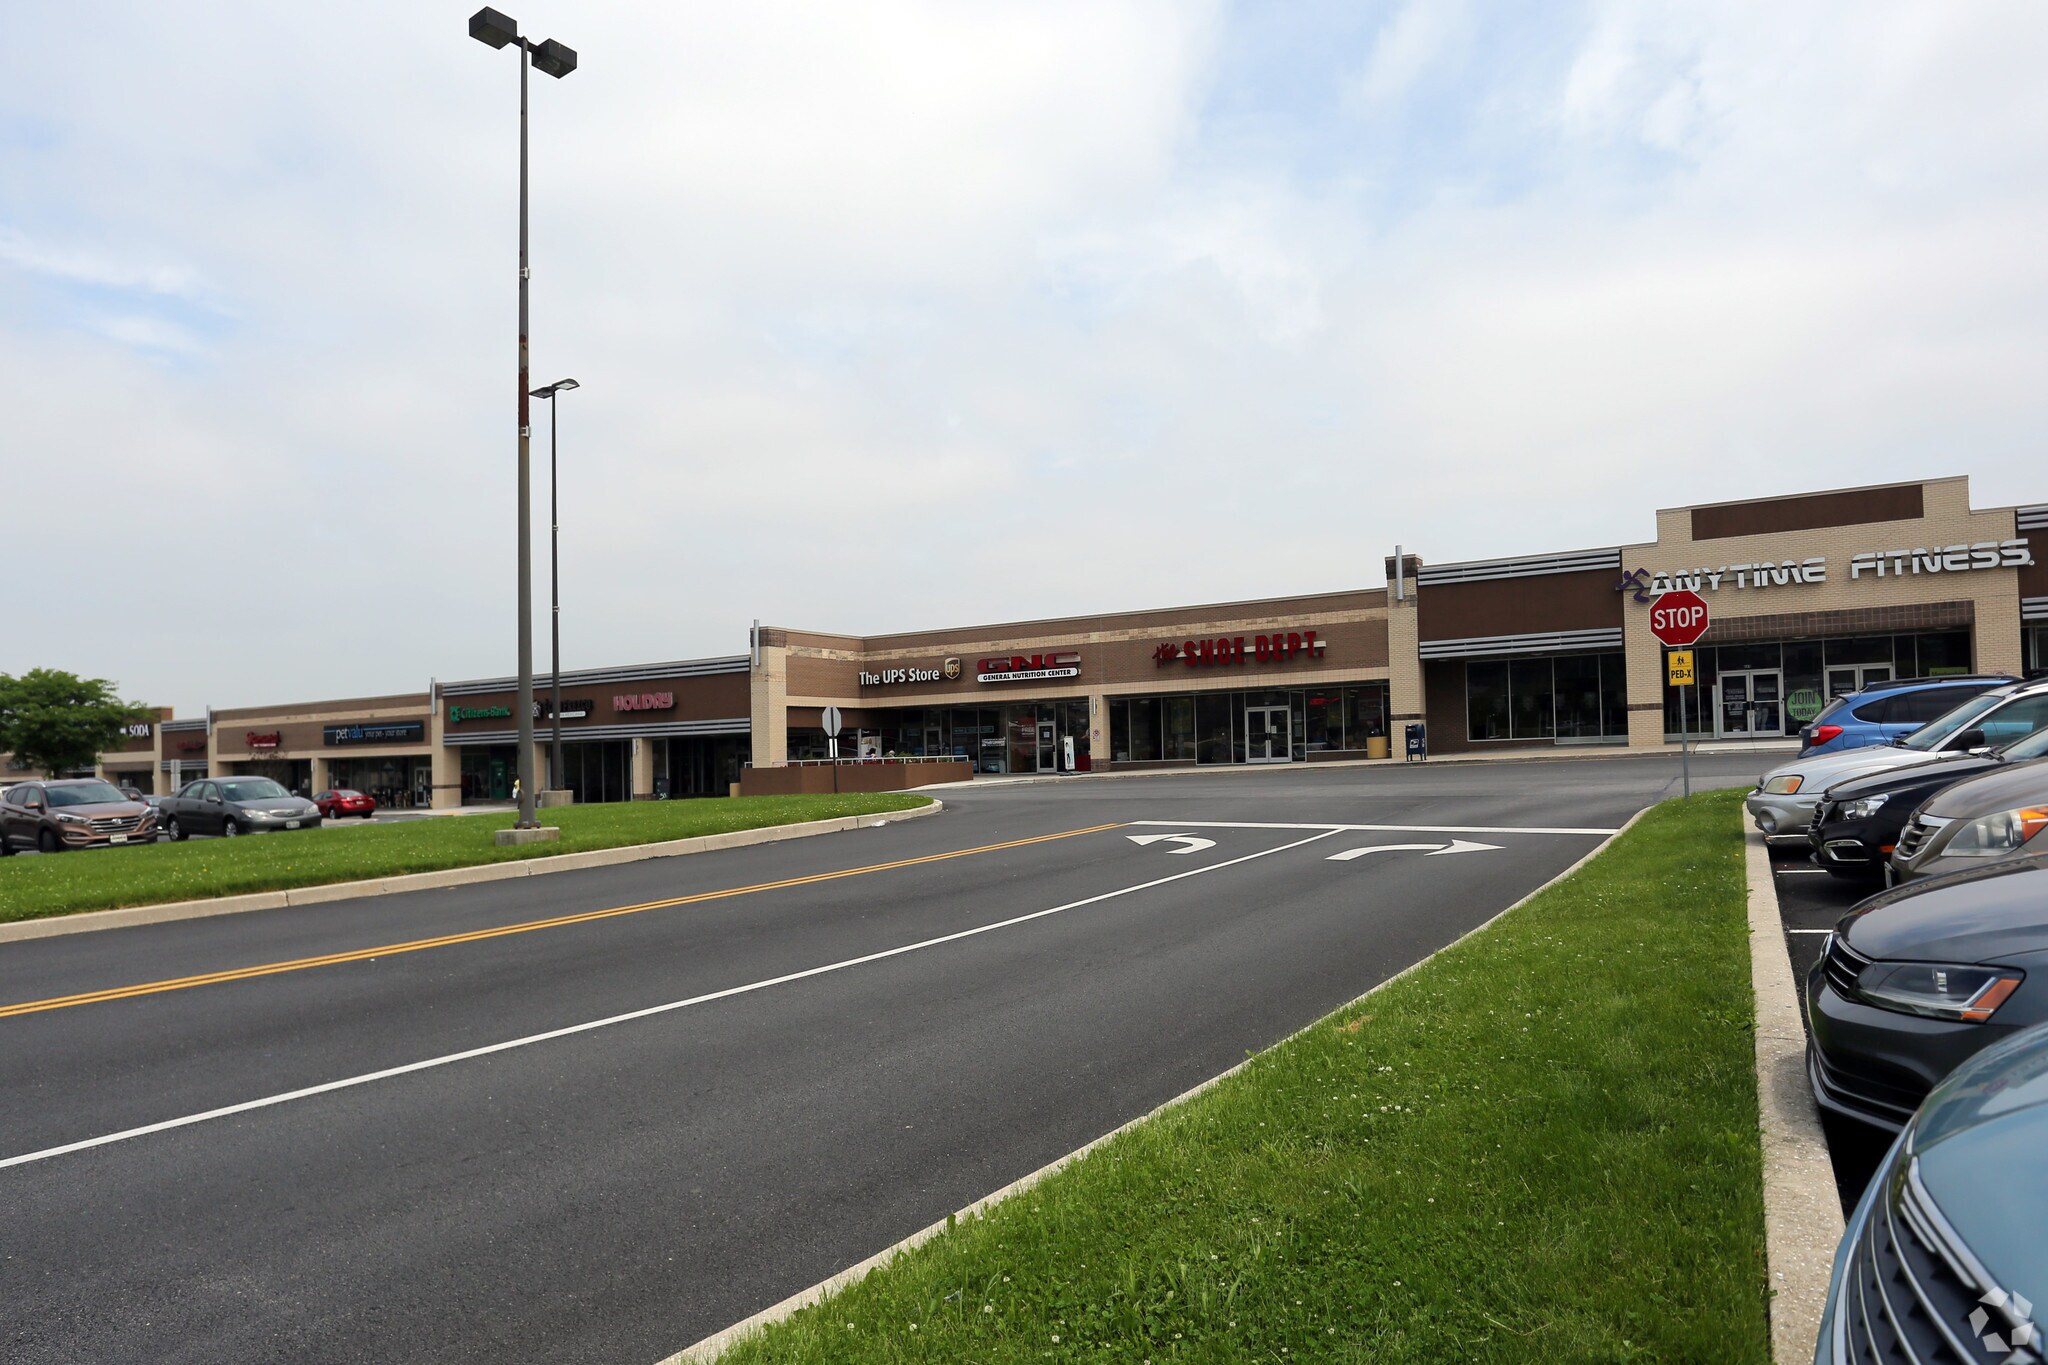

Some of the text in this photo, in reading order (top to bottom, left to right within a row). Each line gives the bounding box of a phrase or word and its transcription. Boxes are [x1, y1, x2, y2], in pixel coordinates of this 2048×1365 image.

[1649, 538, 2031, 596] ANYTIME FITNESS
[1654, 606, 1704, 630] STOP
[1183, 637, 1245, 667] SHOE
[1255, 631, 1324, 662] DEPT.
[946, 663, 959, 676] ups
[977, 652, 1079, 673] GNC
[859, 668, 940, 685] The UPS Store
[983, 669, 1072, 681] GENERAL NUTRITION CENTER
[1671, 668, 1692, 680] PED-X
[613, 692, 673, 711] HOLIDAY
[1791, 691, 1816, 705] JOIN
[461, 705, 511, 719] Citizens Bank
[1792, 707, 1816, 717] TODAY
[129, 725, 150, 737] SODA
